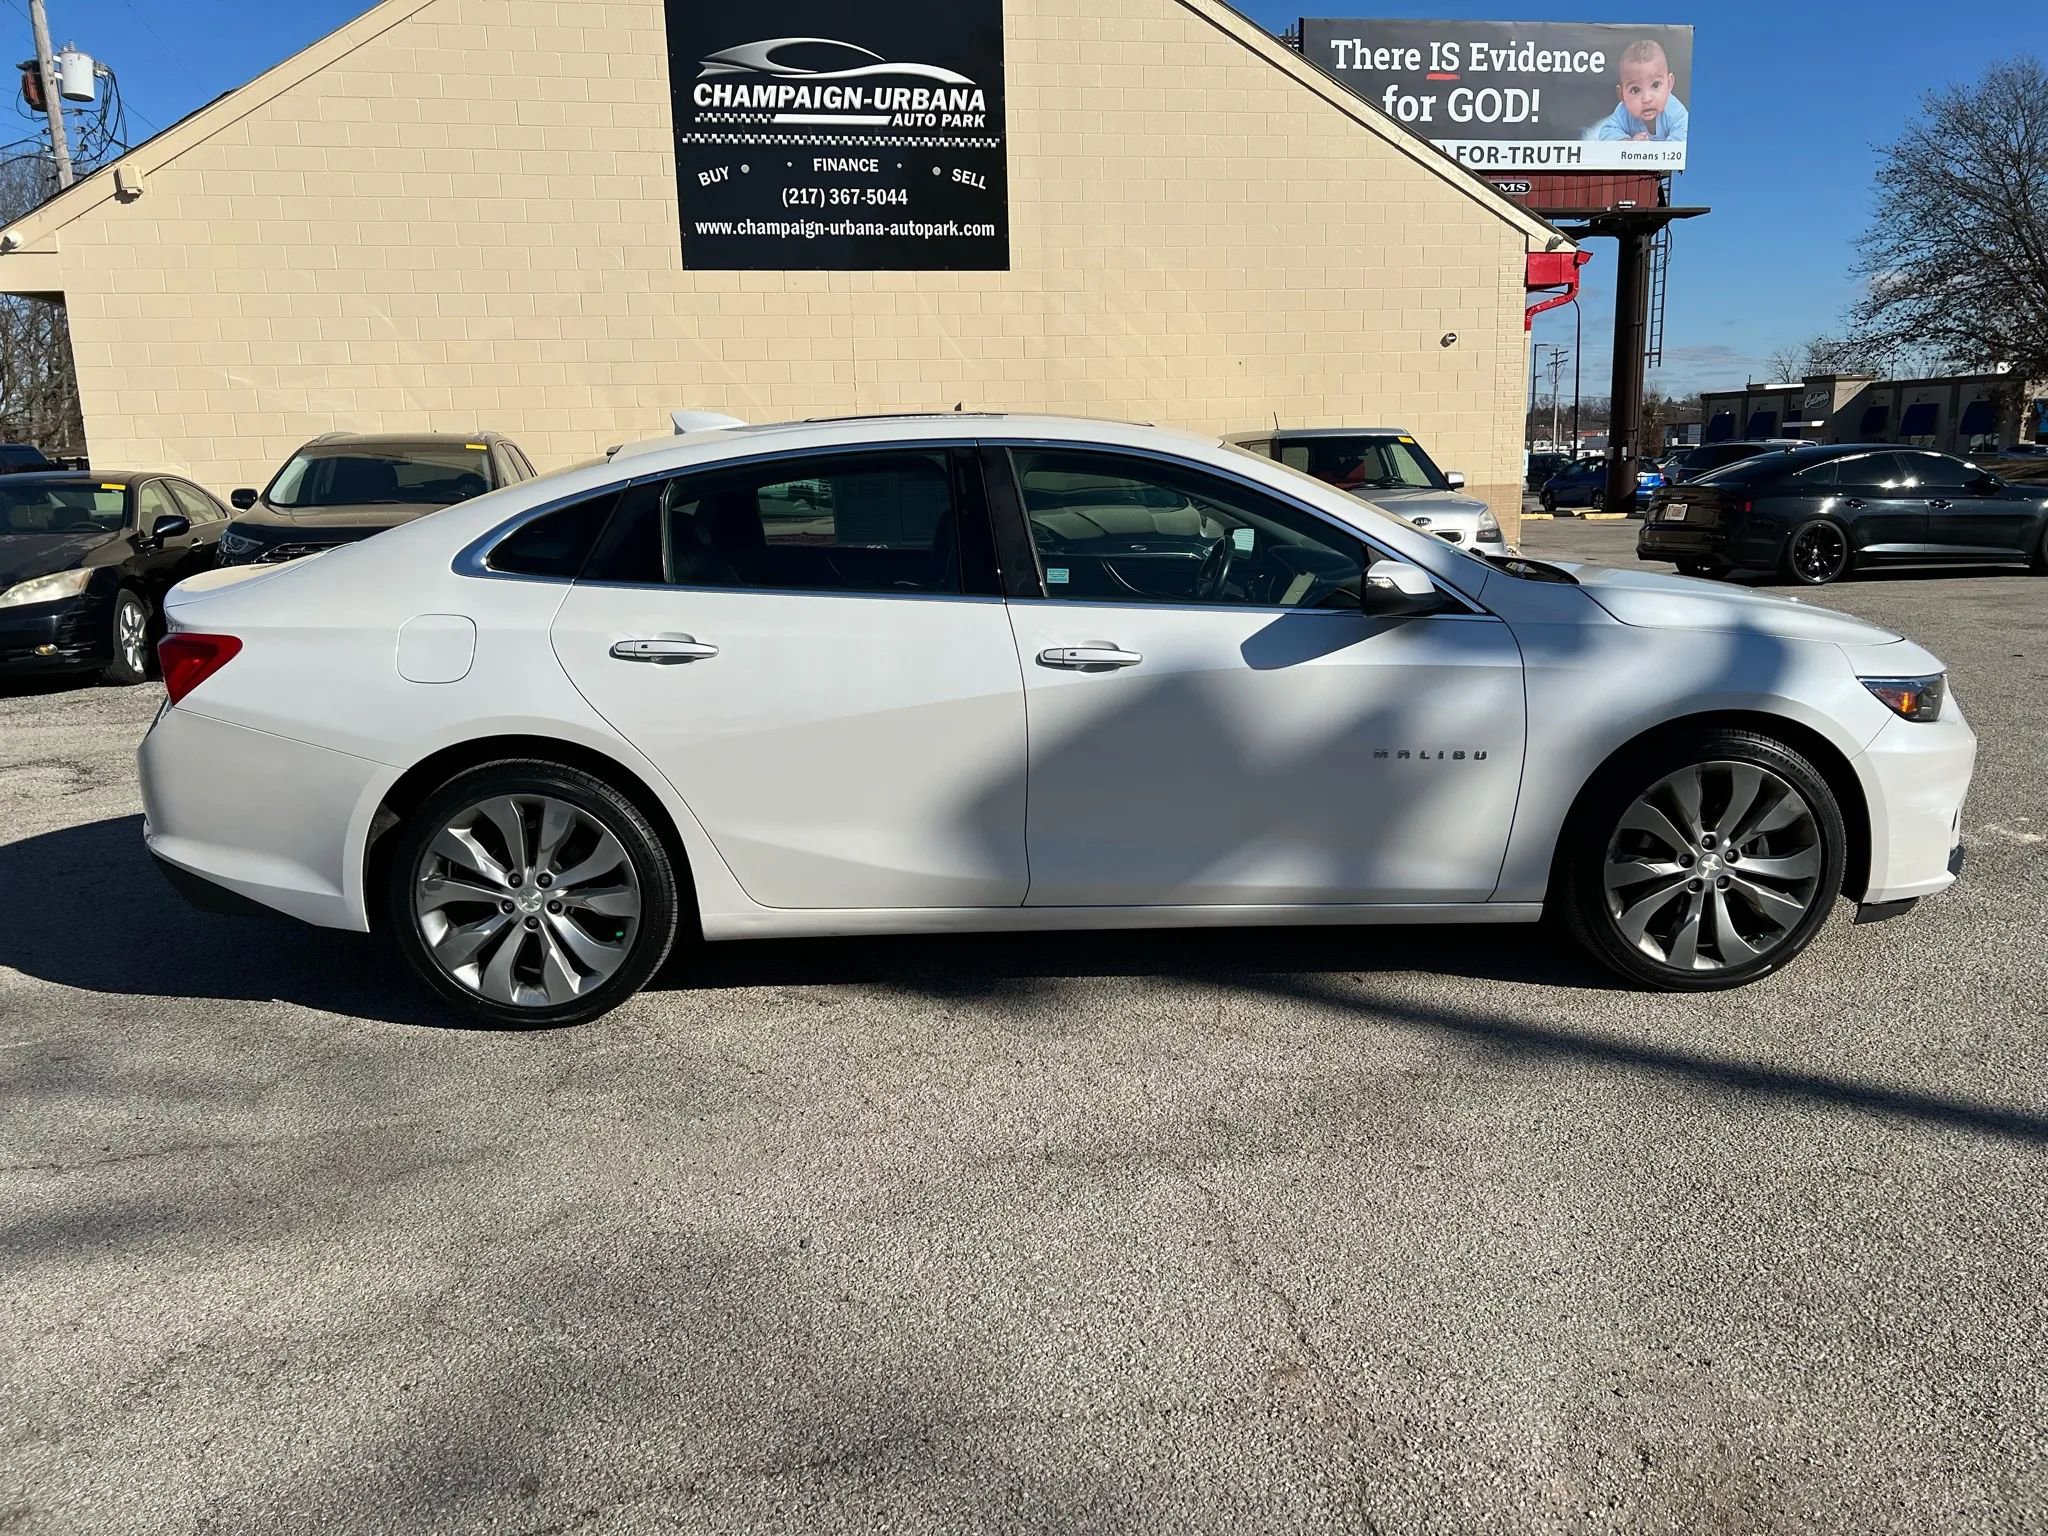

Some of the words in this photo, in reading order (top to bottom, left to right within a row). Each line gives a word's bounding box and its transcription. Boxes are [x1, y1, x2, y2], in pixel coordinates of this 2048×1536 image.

[1331, 39, 1421, 71] There
[1429, 42, 1460, 72] IS
[1469, 42, 1605, 73] Evidence
[693, 84, 986, 111] CHAMPAIGN-URBANA
[1383, 85, 1436, 121] for
[1448, 88, 1539, 123] GOD!
[892, 114, 936, 127] AUTO
[941, 115, 986, 128] PARK
[1456, 146, 1582, 164] FOR-TRUTH
[1621, 151, 1659, 161] Romans
[1662, 152, 1682, 161] 1:20
[698, 166, 730, 186] BUY
[813, 158, 879, 172] FINANCE
[951, 168, 987, 189] SELL
[782, 188, 826, 208] (217)
[829, 189, 908, 205] 367-5044
[695, 219, 995, 239] www.champaign-urbana-autopark.com
[1373, 749, 1488, 760] MALIBU
